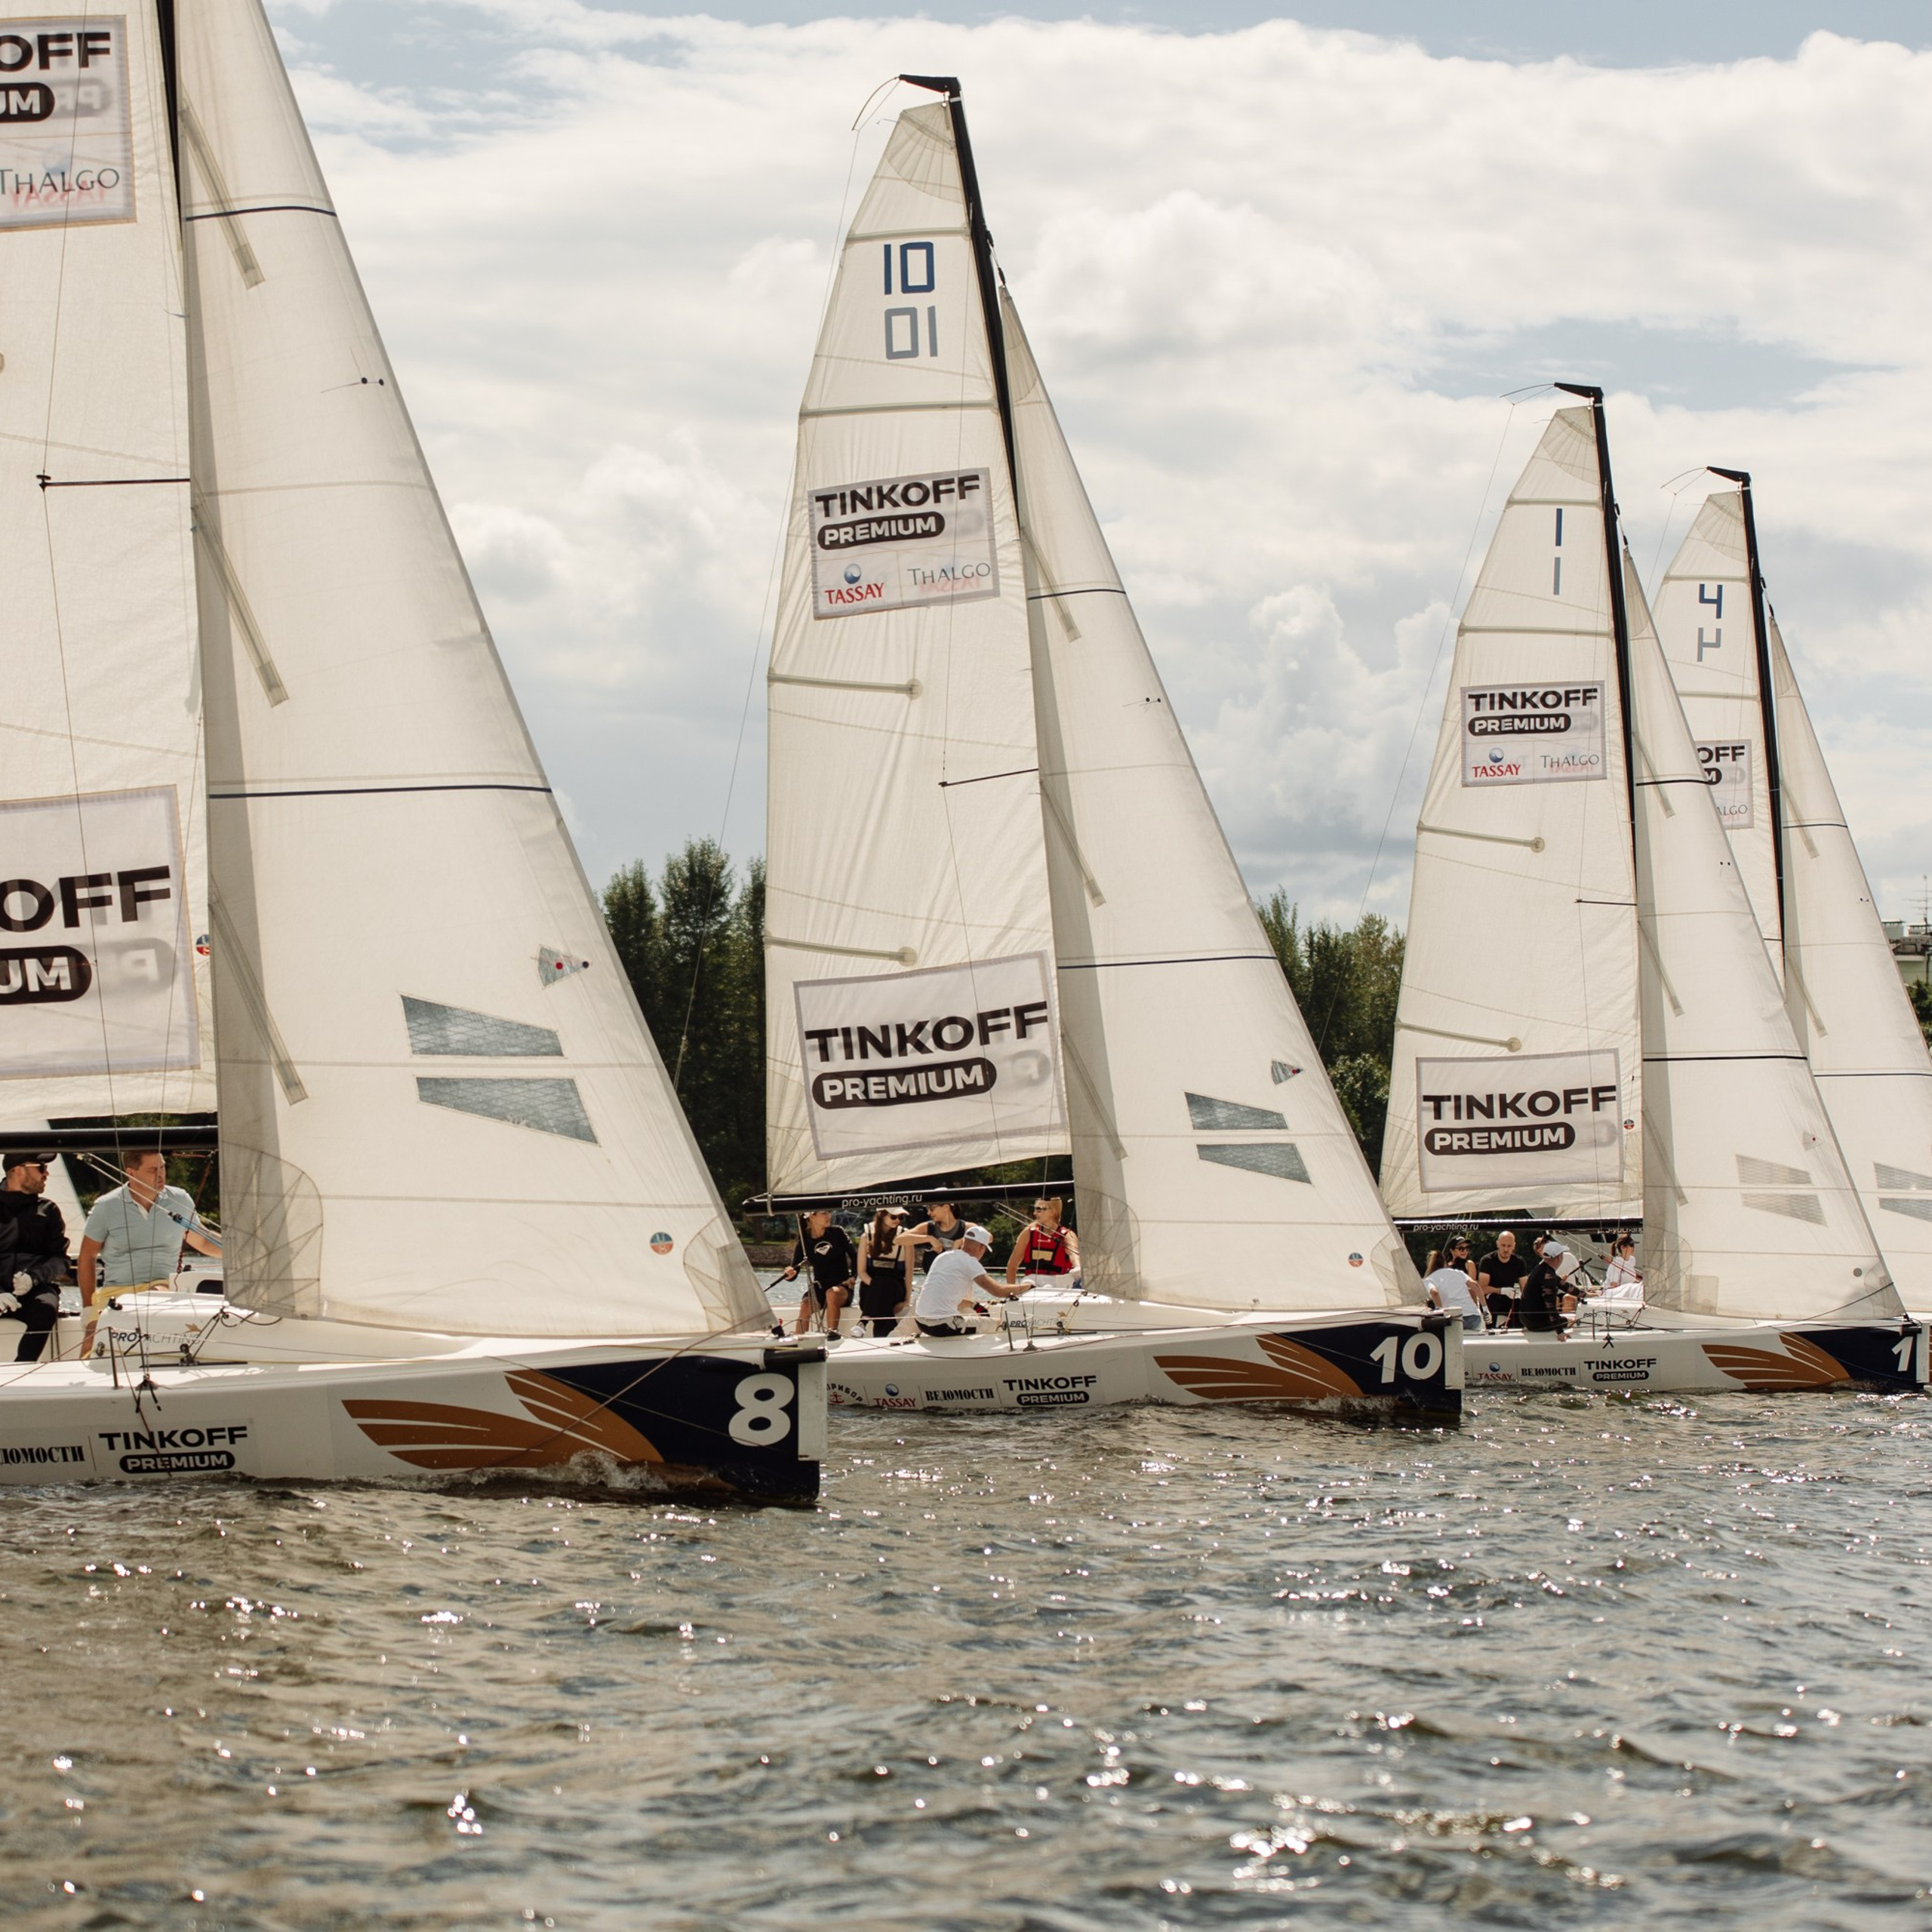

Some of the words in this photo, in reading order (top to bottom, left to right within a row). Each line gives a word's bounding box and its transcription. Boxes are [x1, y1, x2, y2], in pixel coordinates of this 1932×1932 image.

[884, 242, 935, 295] 10
[815, 475, 980, 518] TINKOFF
[825, 516, 936, 545] PREMIUM
[908, 563, 990, 585] THALGO
[824, 583, 884, 605] TASSAY
[1699, 583, 1723, 619] 4
[1468, 688, 1598, 712] TINKOFF
[1475, 717, 1564, 733] PREMIUM
[1472, 764, 1521, 778] TASSAY
[1540, 754, 1599, 768] THALGO
[804, 1001, 1048, 1063] TINKOFF
[822, 1065, 984, 1102] PREMIUM
[1423, 1085, 1617, 1120] TINKOFF
[1433, 1127, 1565, 1150] PREMIUM
[841, 1195, 922, 1209] pro-yachting.ru
[1413, 1223, 1479, 1232] pro-yachting.ru
[1370, 1332, 1443, 1383] 10
[1584, 1358, 1657, 1370] TINKOFF
[1891, 1336, 1913, 1371] 1
[1003, 1375, 1097, 1391] TINKOFF
[1595, 1372, 1645, 1380] PREMIUM
[873, 1398, 916, 1407] TASSAY
[1020, 1393, 1085, 1404] PREMIUM
[729, 1373, 795, 1447] 8
[99, 1426, 248, 1451] TINKOFF
[127, 1454, 228, 1471] PREMIUM
